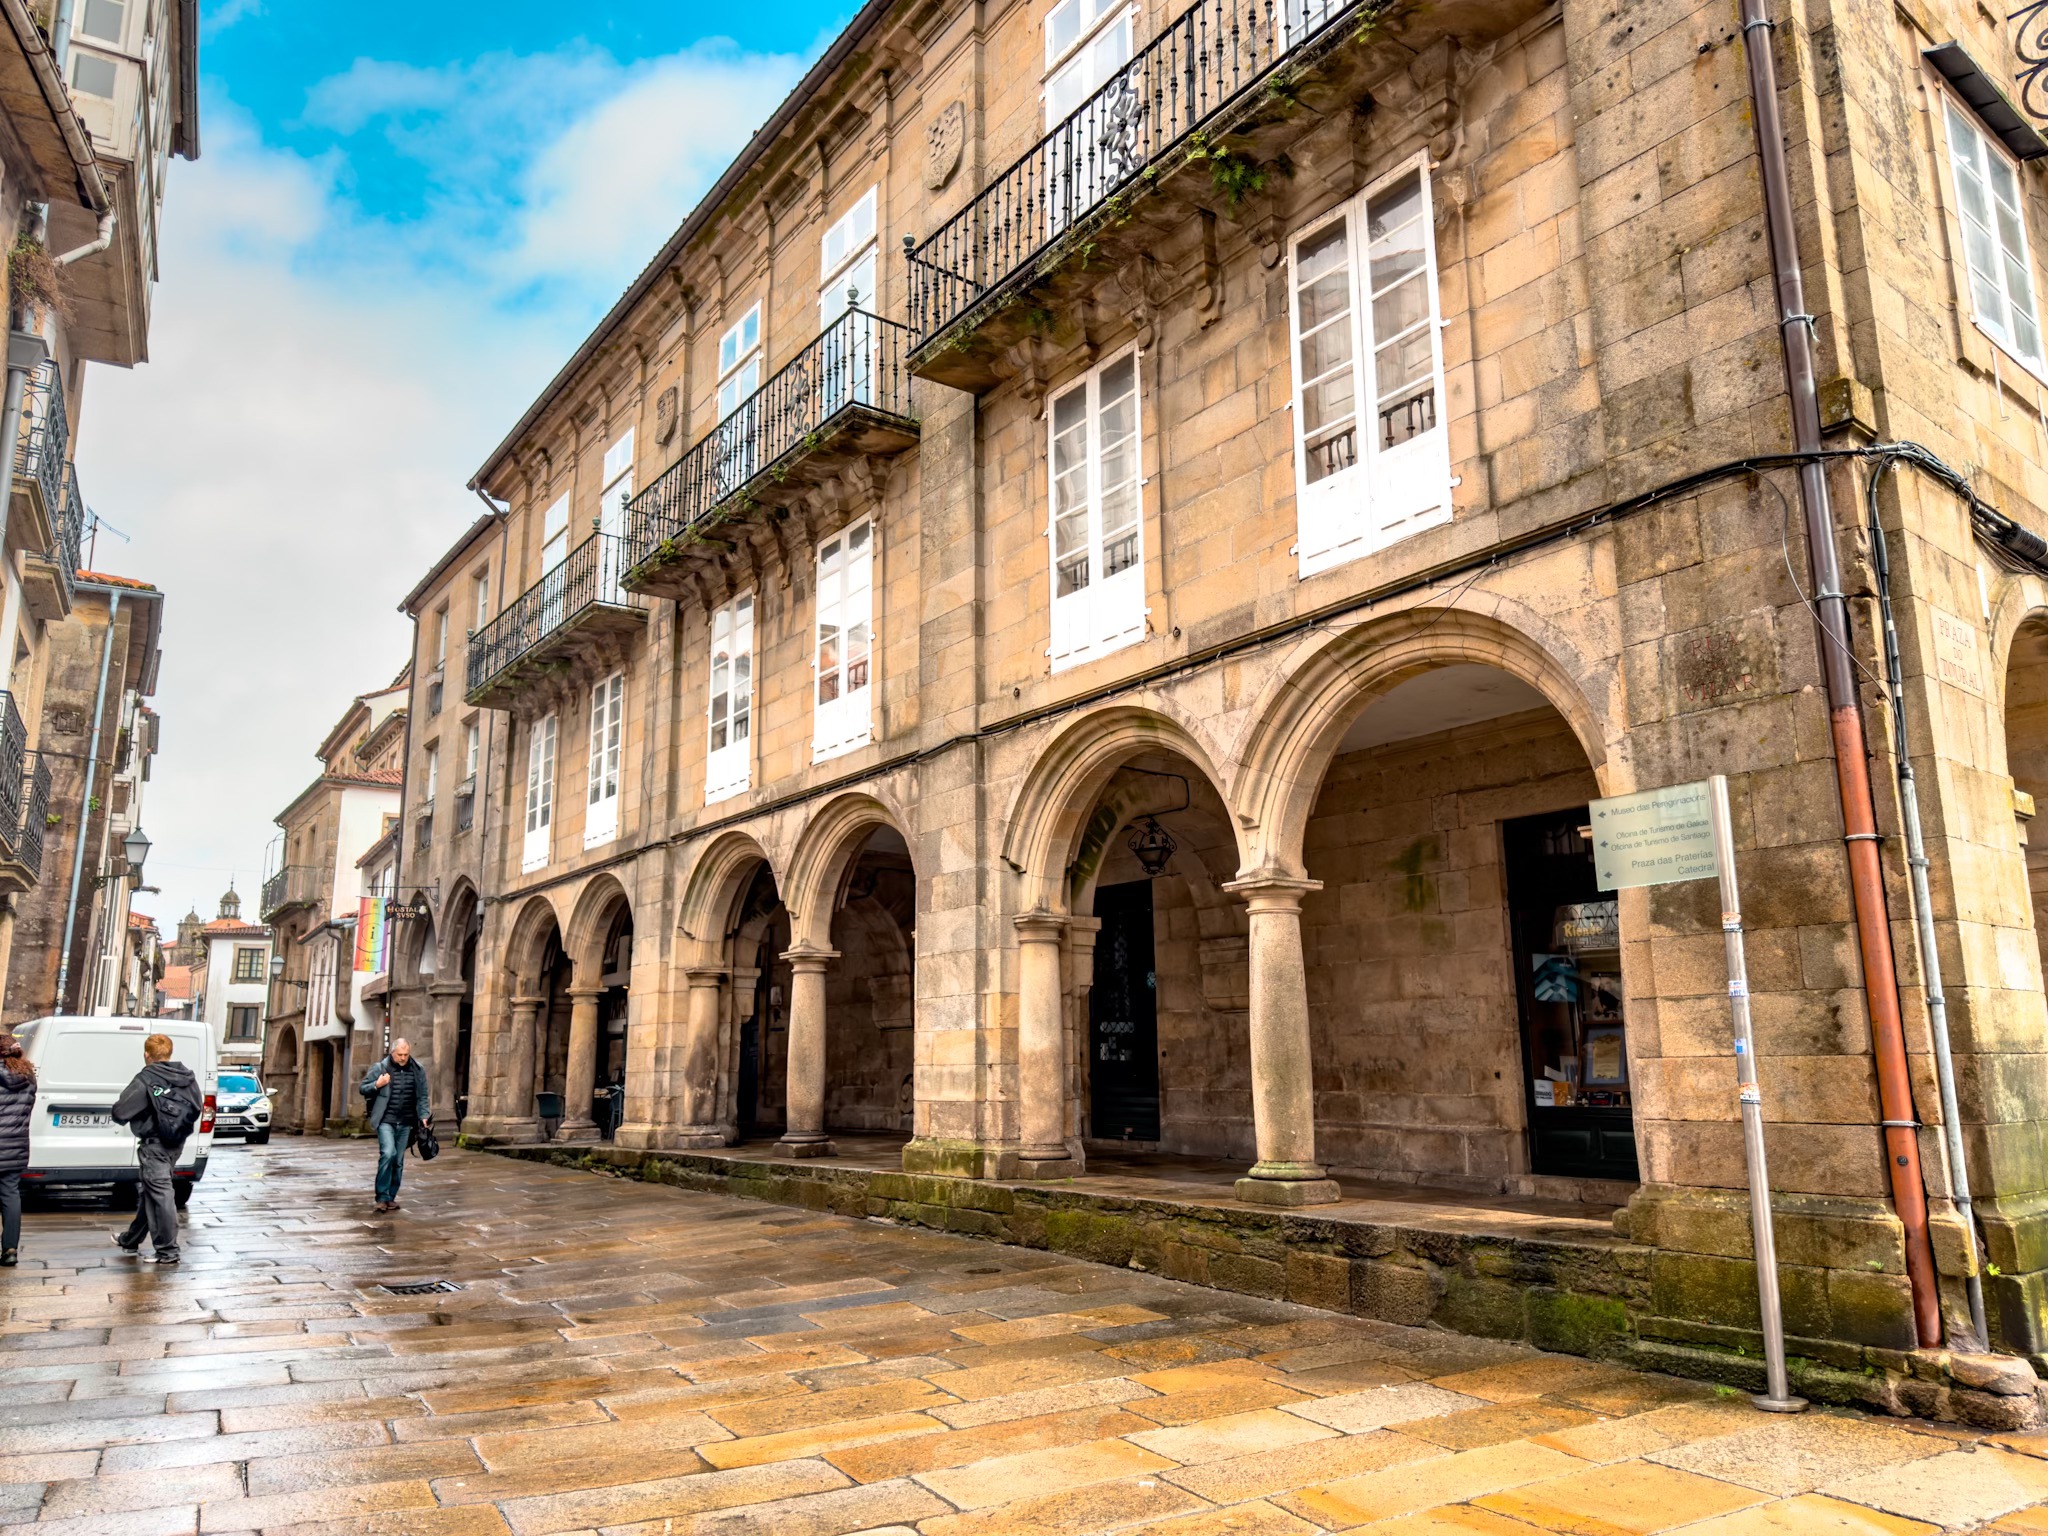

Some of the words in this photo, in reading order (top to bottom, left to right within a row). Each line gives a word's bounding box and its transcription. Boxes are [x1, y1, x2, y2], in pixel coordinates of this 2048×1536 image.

[1939, 617, 1971, 649] PRAZA
[1953, 647, 1963, 661] DO
[1940, 657, 1981, 692] TOURAL
[1683, 673, 1757, 701] VILAR
[1611, 806, 1635, 816] Museo
[1636, 803, 1650, 812] das
[1616, 830, 1638, 840] Oficina
[1638, 828, 1648, 836] de
[1649, 824, 1675, 835] Turismo
[1675, 822, 1685, 830] de
[1686, 818, 1709, 829] Galicia
[1611, 842, 1633, 852] Oficina
[1633, 840, 1642, 848] de
[1643, 837, 1670, 847] Turismo
[1670, 835, 1680, 843] de
[1680, 830, 1711, 842] Santiago
[1631, 858, 1656, 869] Praza
[1657, 855, 1673, 865] das
[1674, 849, 1714, 863] Praterías
[1678, 862, 1715, 875] Catedral
[387, 906, 418, 914] HOSTAL
[61, 1115, 90, 1125] 8459
